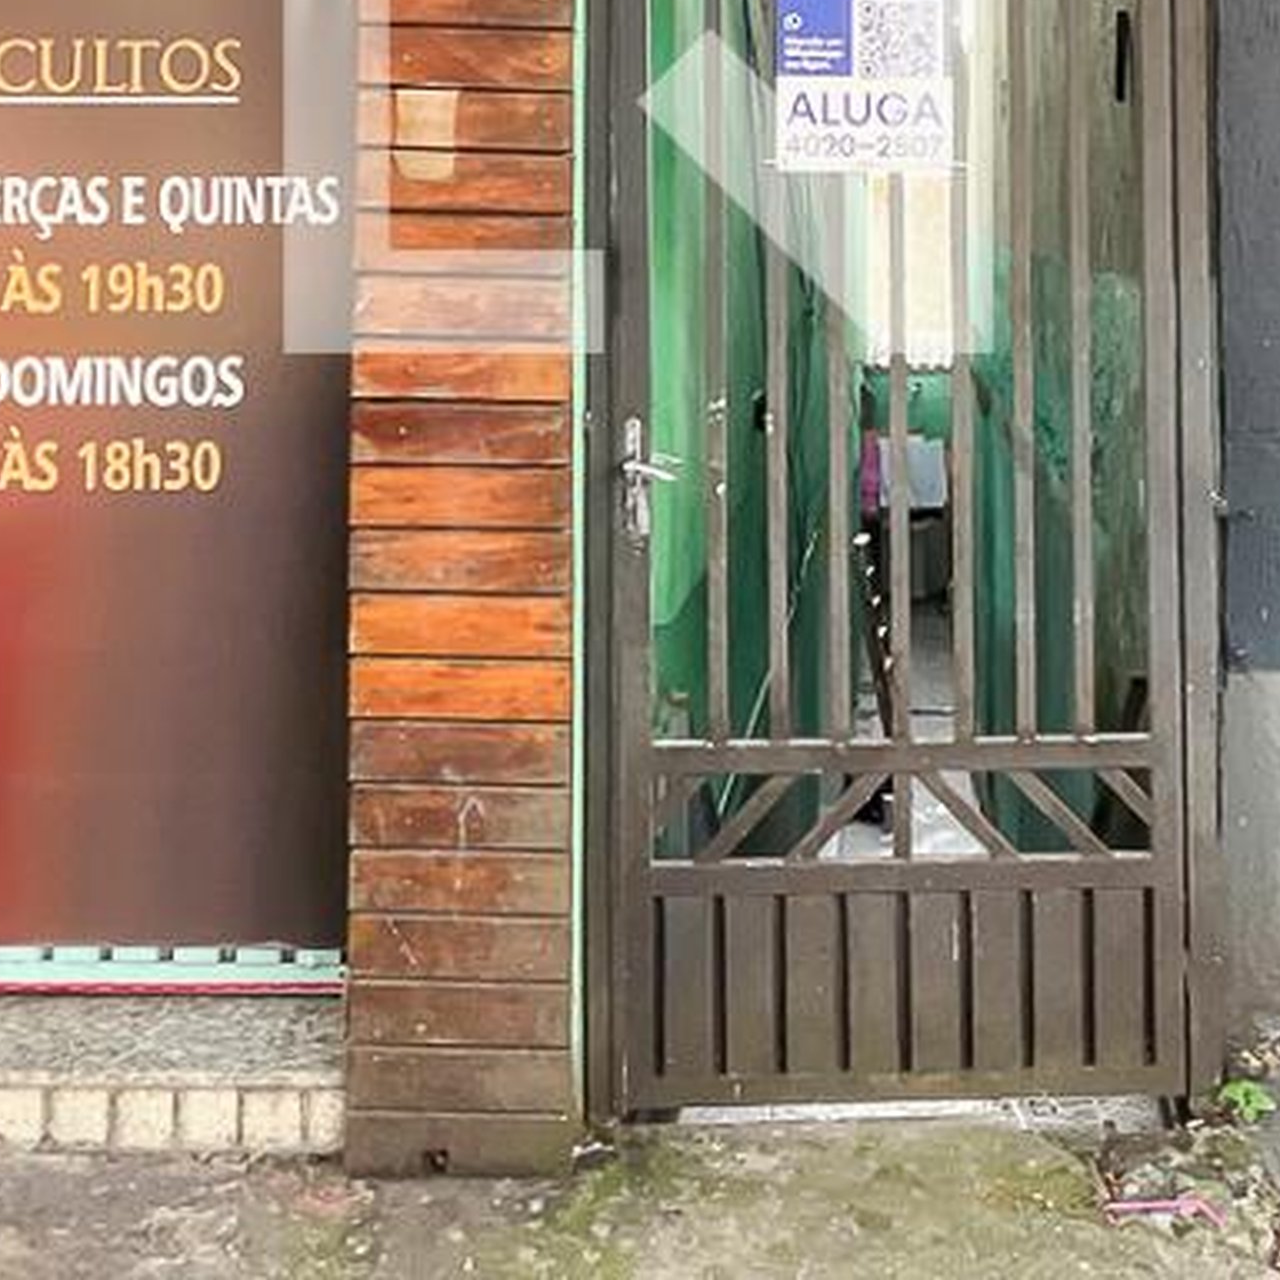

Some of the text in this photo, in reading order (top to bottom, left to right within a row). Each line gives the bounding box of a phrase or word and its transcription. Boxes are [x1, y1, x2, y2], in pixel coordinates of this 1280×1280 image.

[786, 91, 944, 127] ALUGA
[122, 176, 146, 224] E
[158, 176, 340, 234] QUINTAS
[0, 249, 224, 314] ÀS 19h30
[77, 438, 222, 492] 18h30
